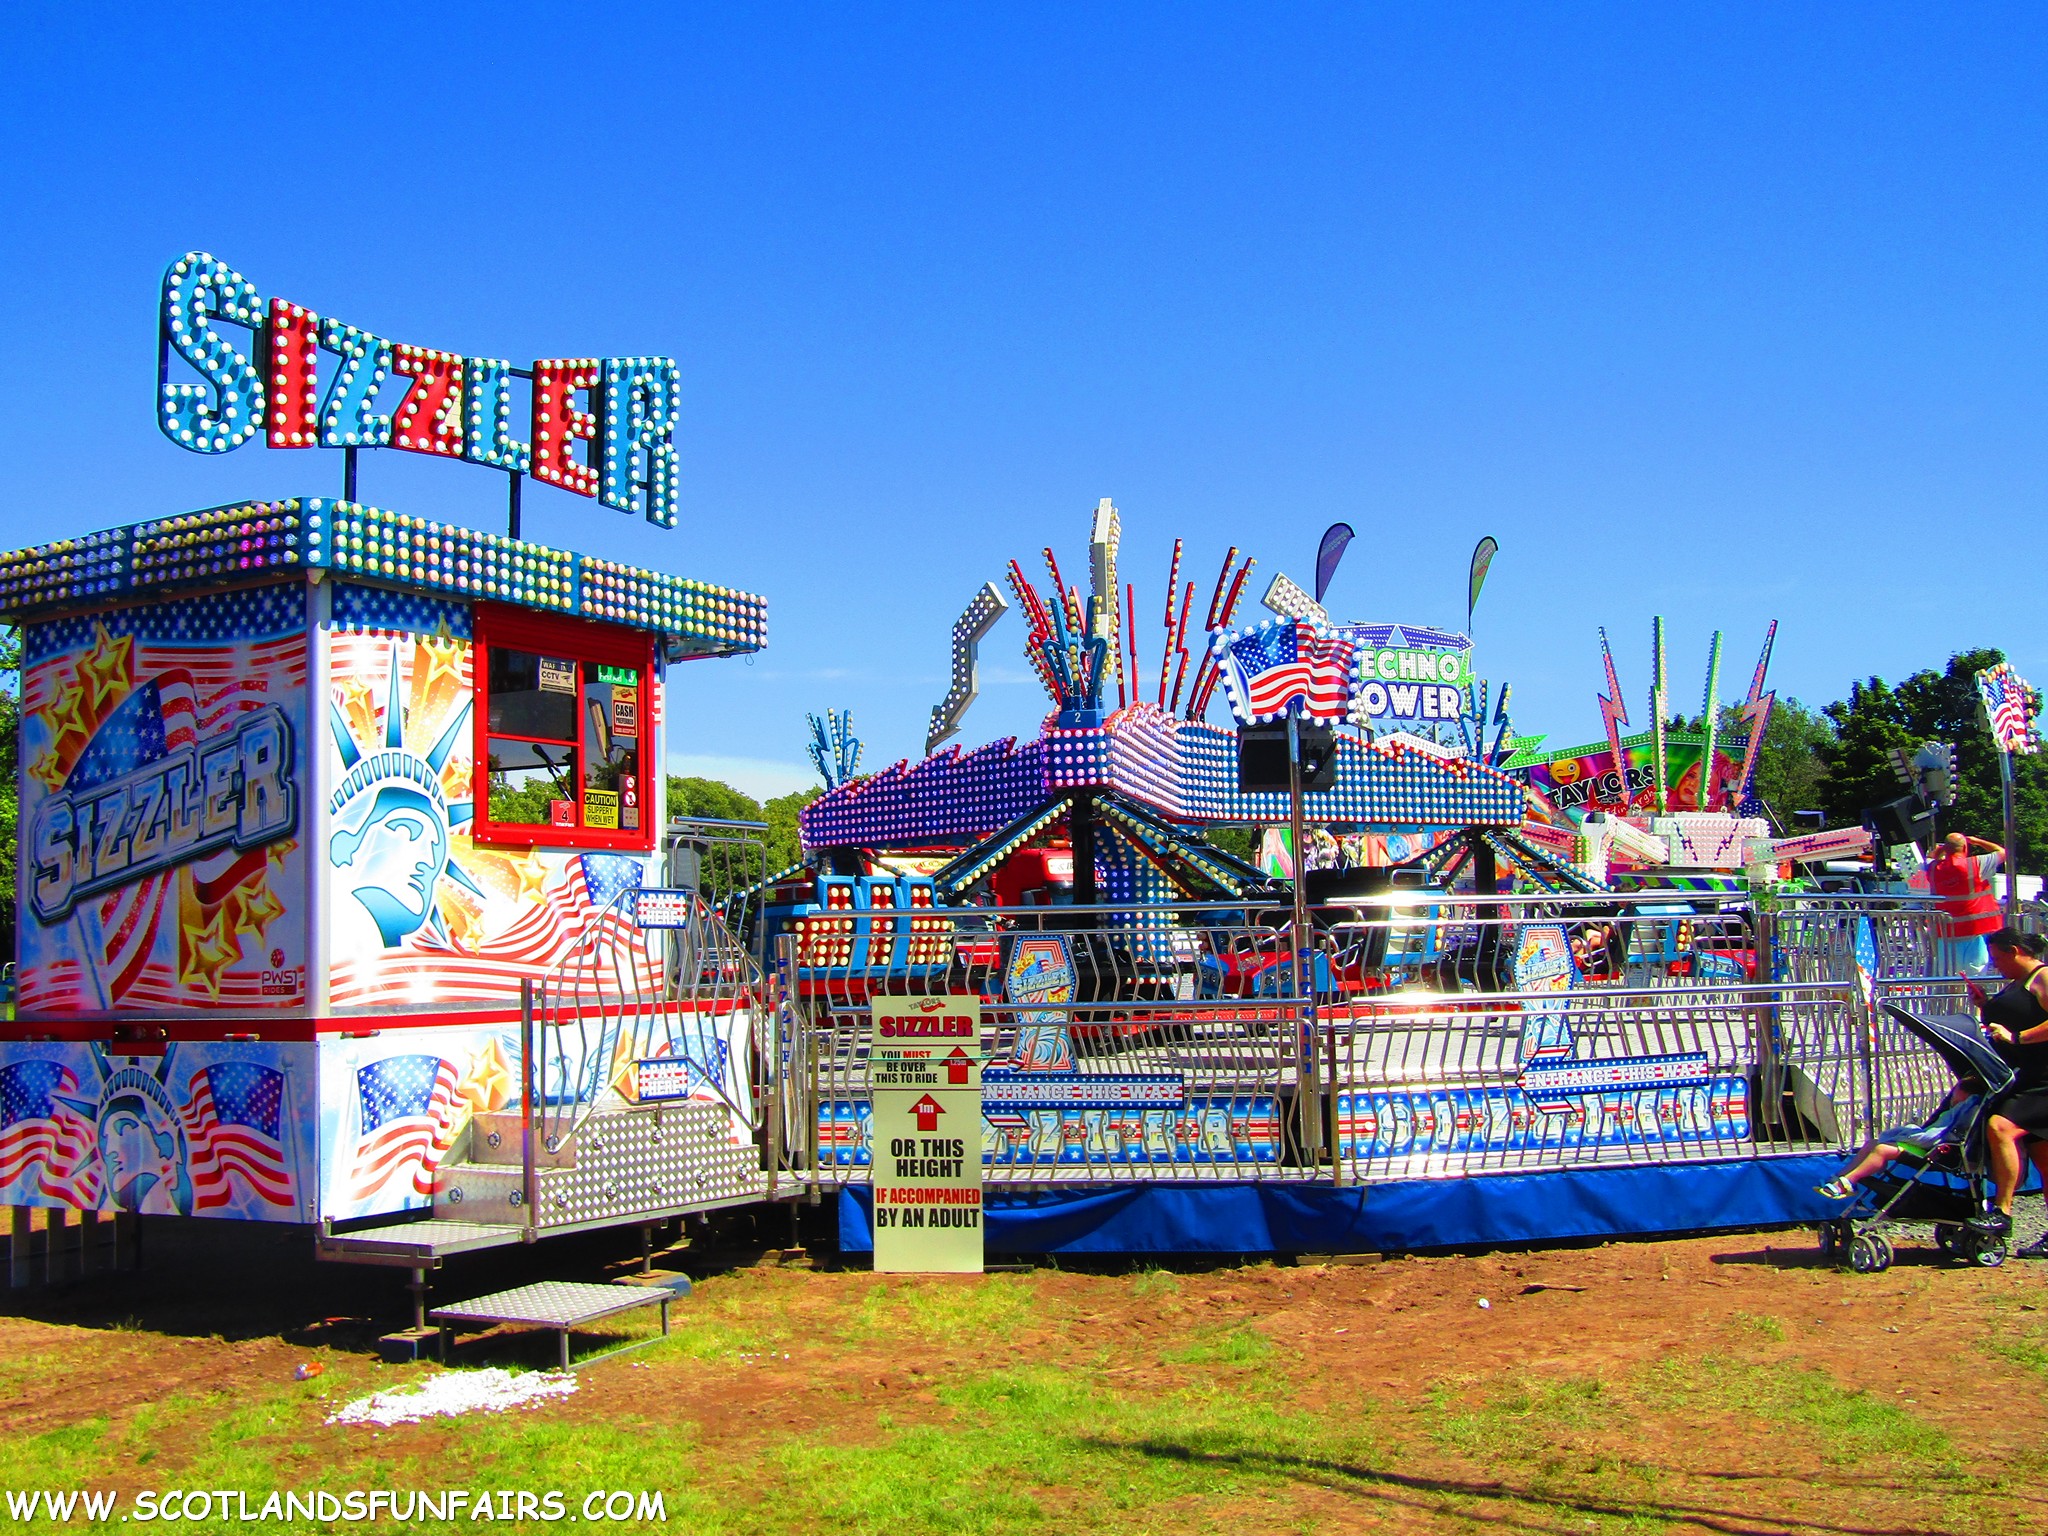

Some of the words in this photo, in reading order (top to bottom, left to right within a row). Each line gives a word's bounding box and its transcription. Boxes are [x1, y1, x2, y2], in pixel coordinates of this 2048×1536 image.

[158, 251, 680, 529] SIZZLER
[1361, 649, 1460, 682] ECHNO
[541, 671, 560, 681] CCTV
[1360, 682, 1460, 718] OWER
[616, 704, 634, 718] CASH
[1075, 712, 1081, 723] 2
[584, 793, 616, 806] CAUTION
[33, 712, 290, 912] SIZZLER
[561, 810, 568, 822] 4
[587, 805, 614, 815] SLIPPERY
[586, 814, 602, 823] WHEN
[603, 816, 615, 825] WET
[647, 893, 678, 910] PAY
[645, 909, 678, 925] HERE
[879, 1015, 973, 1037] SIZZLER
[881, 1050, 900, 1059] YOU
[903, 1050, 932, 1059] MUST
[648, 1061, 679, 1078] PAY
[886, 1062, 898, 1072] BE
[900, 1062, 926, 1072] OVER
[1524, 1067, 1613, 1089] ENTRANCE
[1617, 1065, 1656, 1082] THIS
[1659, 1061, 1706, 1079] WAY
[875, 1073, 898, 1083] THIS
[900, 1073, 912, 1083] TO
[915, 1073, 938, 1083] RIDE
[646, 1078, 679, 1095] HERE
[1080, 1085, 1122, 1100] THIS
[1126, 1084, 1180, 1099] WAY
[918, 1103, 934, 1113] 1m
[890, 1138, 916, 1157] OR
[920, 1138, 964, 1157] THIS
[896, 1159, 964, 1177] HEIGHT
[876, 1188, 887, 1203] IF
[889, 1188, 981, 1204] ACCOMPANIED
[876, 1208, 898, 1227] BY
[902, 1208, 924, 1227] AN
[928, 1208, 979, 1228] ADULT
